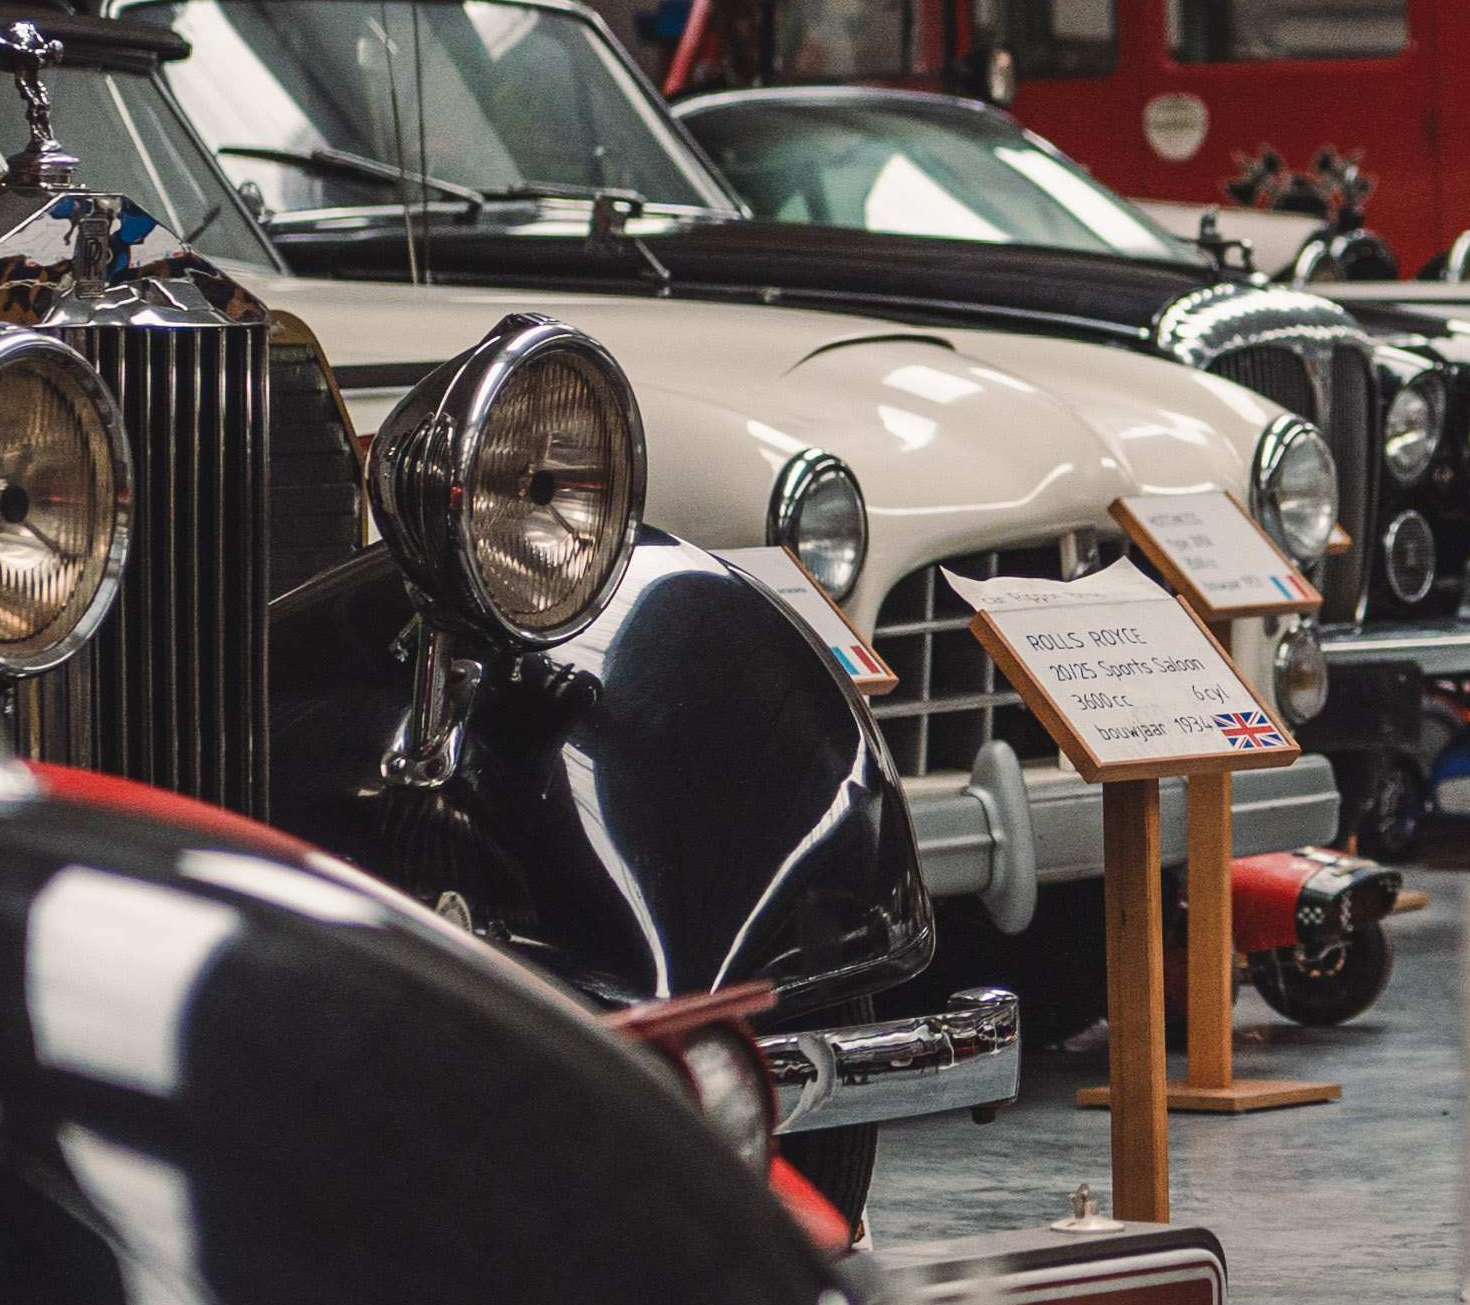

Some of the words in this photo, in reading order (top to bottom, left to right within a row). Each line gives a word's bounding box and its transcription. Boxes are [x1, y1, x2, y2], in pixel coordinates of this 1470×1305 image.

[1026, 631, 1085, 652] ROLLS
[1088, 627, 1147, 647] ROYCE
[1049, 661, 1098, 682] 20/25
[1097, 657, 1154, 681] Sports
[1151, 655, 1206, 673] Saloon
[1094, 722, 1167, 742] bouwjaar
[1173, 715, 1214, 733] 1934
